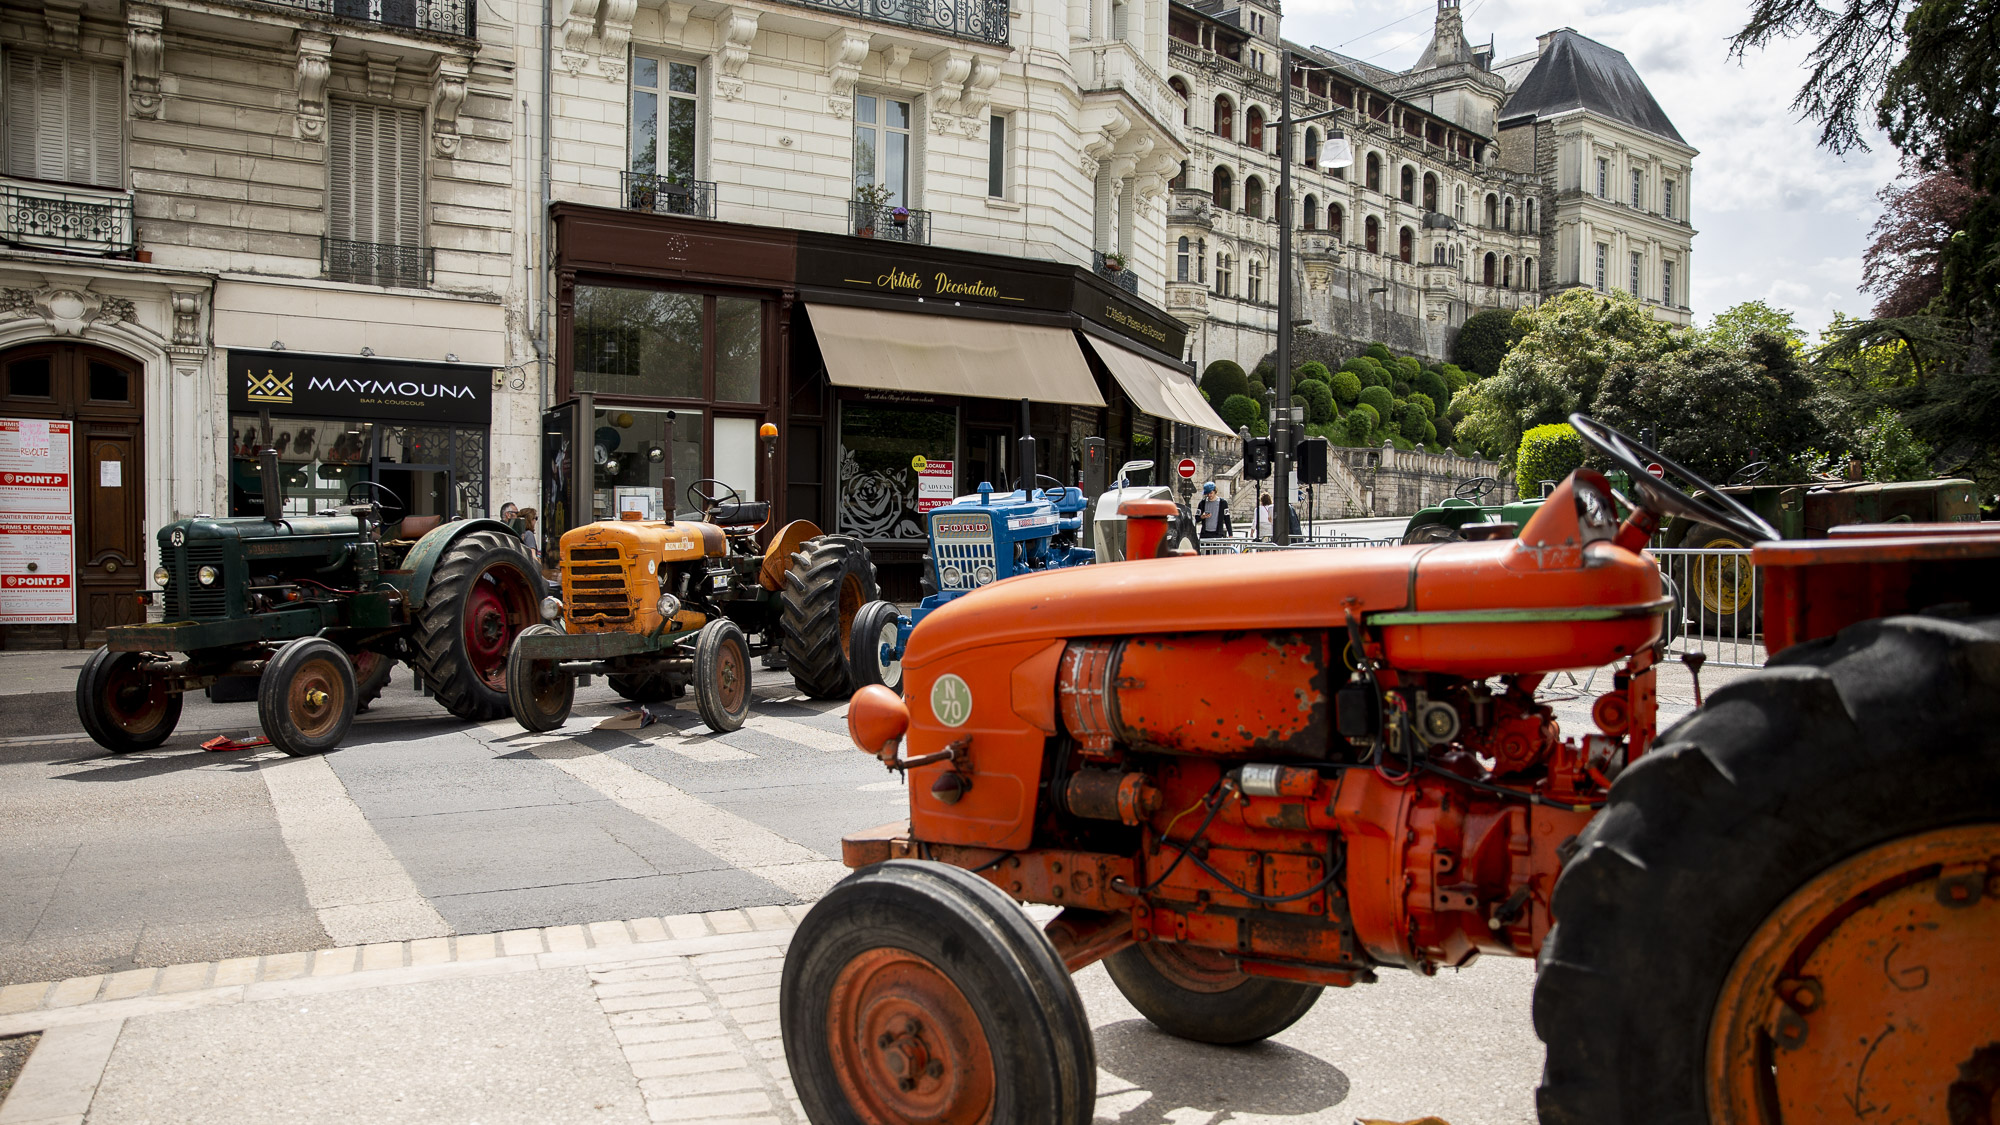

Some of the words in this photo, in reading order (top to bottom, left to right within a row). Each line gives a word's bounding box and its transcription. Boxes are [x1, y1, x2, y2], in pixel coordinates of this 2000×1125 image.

[877, 266, 922, 290] Artiste
[934, 272, 1000, 298] Décorateur
[308, 376, 476, 399] MAYMOUNA
[21, 447, 48, 457] REVOLTE
[15, 475, 62, 484] POINT.P
[939, 523, 988, 532] FORD
[18, 577, 65, 586] POINT.P
[945, 680, 956, 699] N
[941, 700, 962, 720] 70
